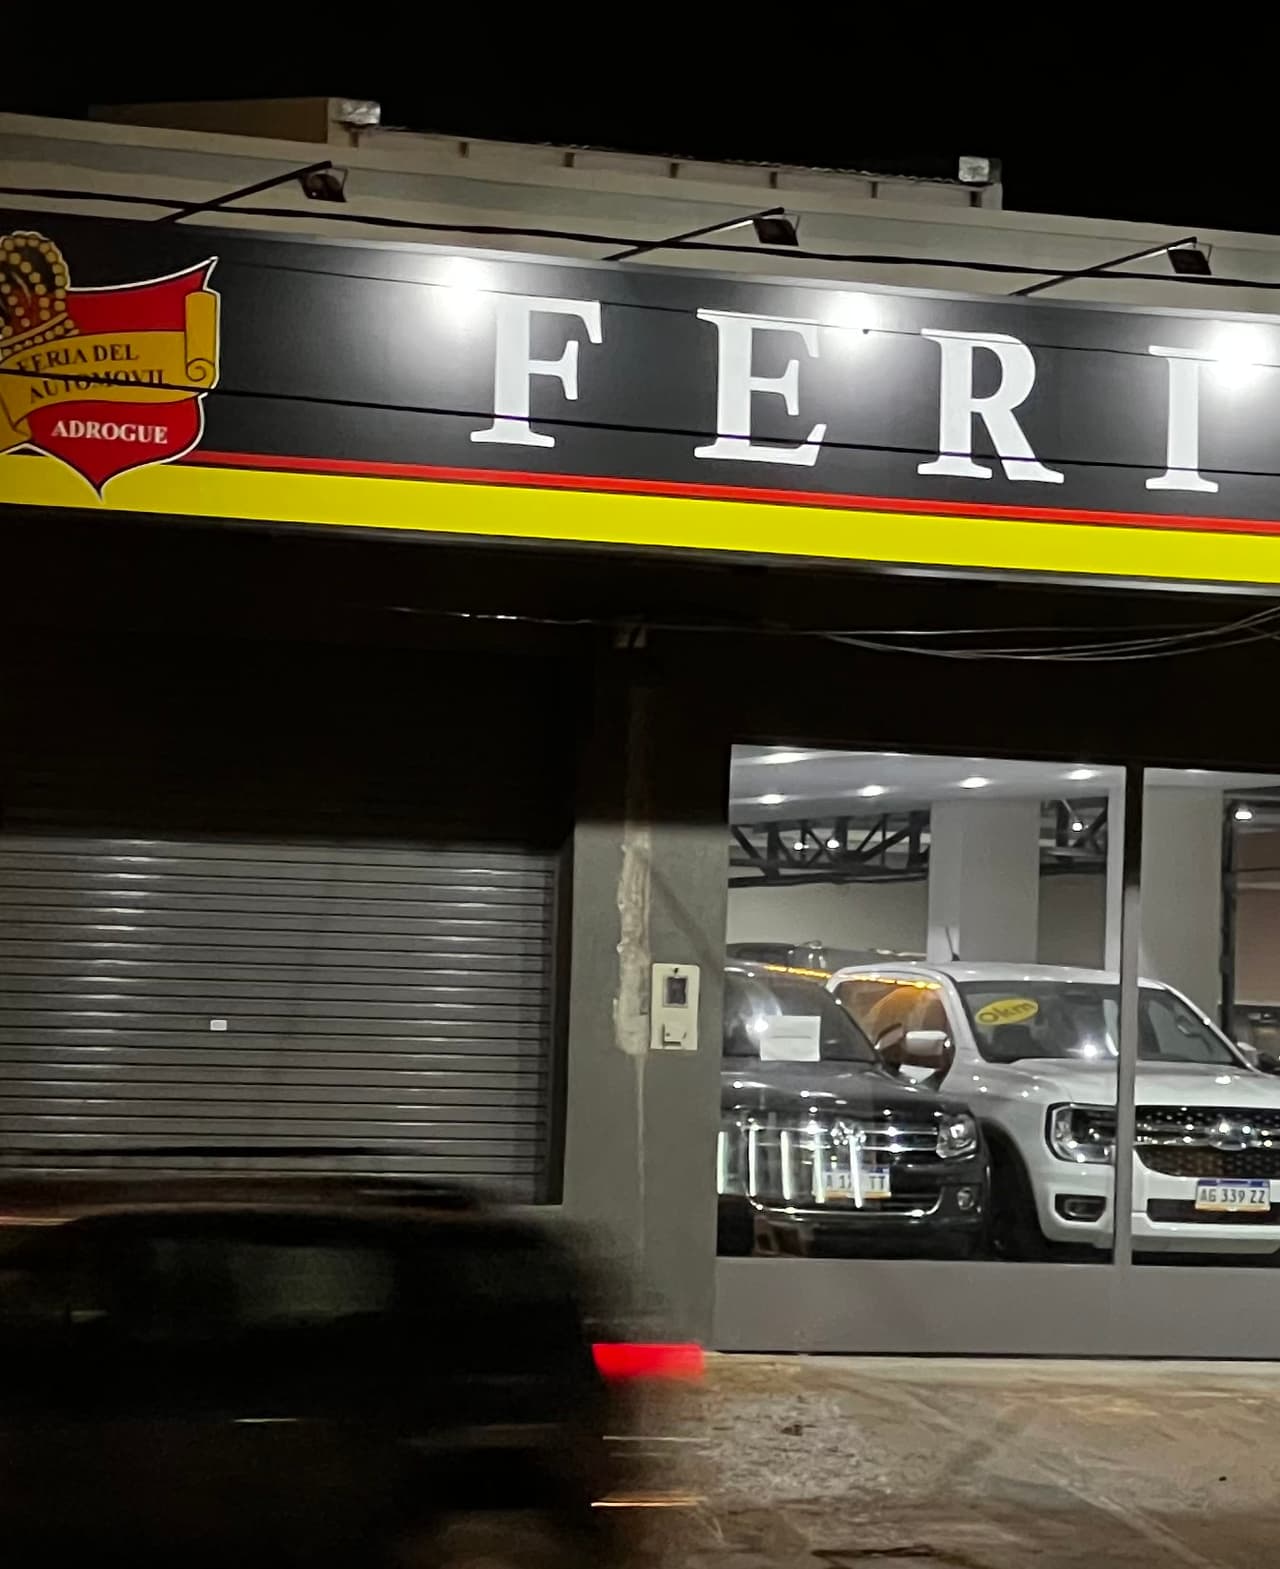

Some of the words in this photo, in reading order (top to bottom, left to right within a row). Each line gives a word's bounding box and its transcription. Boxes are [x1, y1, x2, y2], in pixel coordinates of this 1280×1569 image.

[17, 346, 88, 373] FERIA
[92, 342, 139, 364] DEL
[51, 419, 169, 446] ADROGUE
[1221, 1188, 1246, 1203] 339
[1250, 1189, 1266, 1204] ZZ
